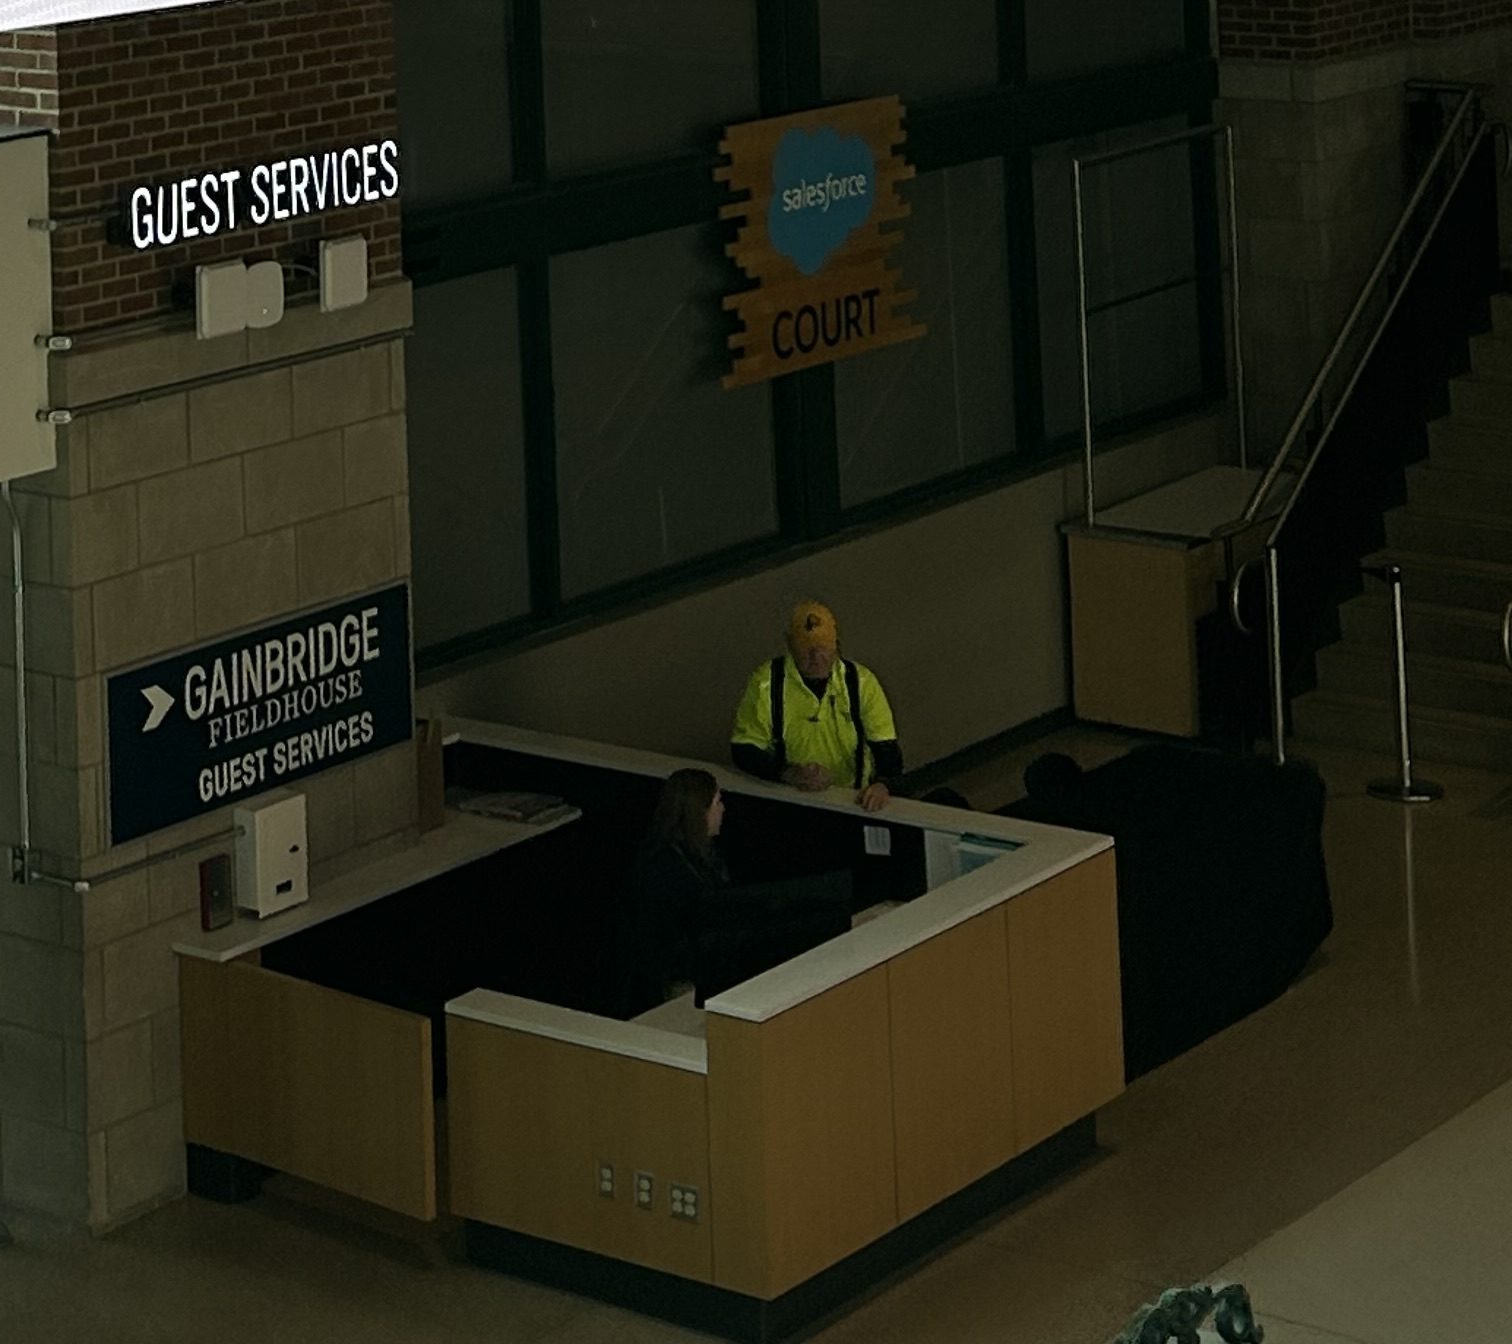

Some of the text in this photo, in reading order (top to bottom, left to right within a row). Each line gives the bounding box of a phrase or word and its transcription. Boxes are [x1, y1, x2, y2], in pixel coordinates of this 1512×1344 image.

[130, 140, 400, 249] GUEST SERVICES
[782, 172, 867, 212] salesforce
[772, 288, 880, 360] COURT
[184, 606, 380, 720] GAINBRIDGE
[208, 669, 363, 749] FIELDHOUSE
[198, 711, 374, 802] GUEST SERVICES
